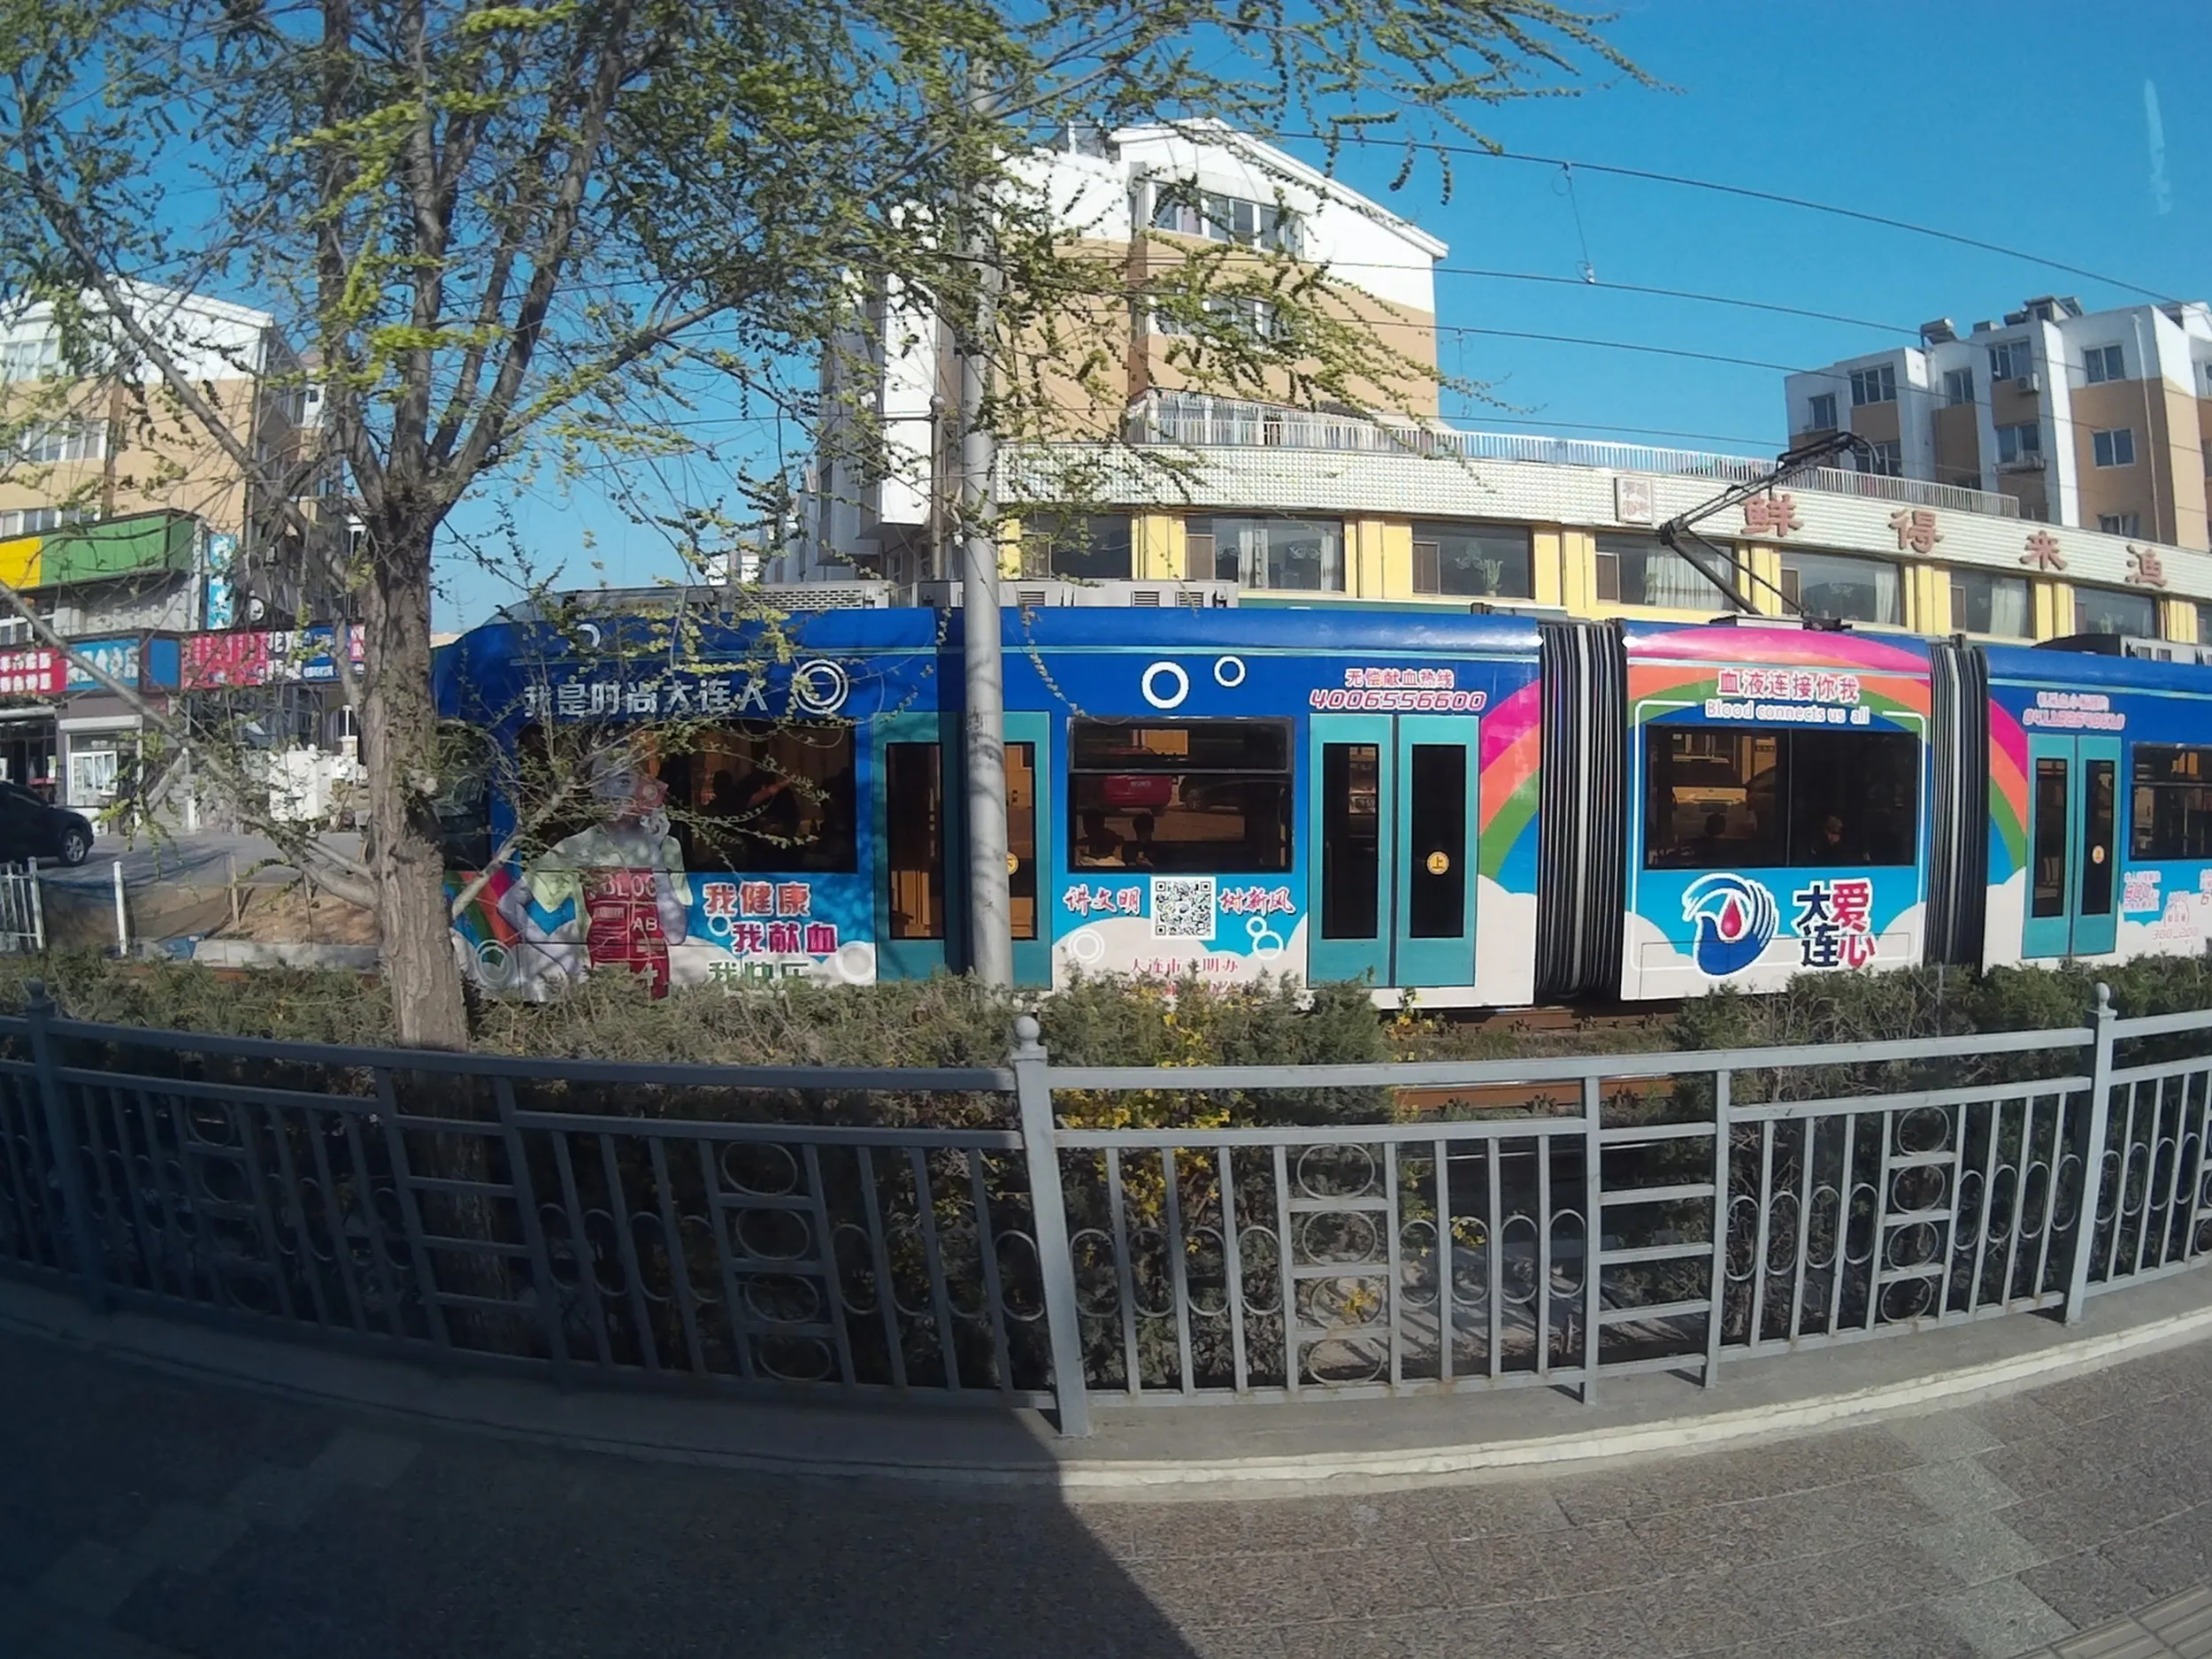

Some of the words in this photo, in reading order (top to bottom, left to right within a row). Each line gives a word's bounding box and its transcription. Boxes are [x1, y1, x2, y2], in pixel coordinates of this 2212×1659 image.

[1346, 669, 1454, 688] 无偿献血热线
[1718, 671, 1860, 702] 血液连接你我
[525, 680, 768, 718] 我是时尚大连人
[1310, 690, 1486, 710] 4006556600
[1706, 700, 1754, 718] Blood
[1756, 703, 1824, 723] connects
[1827, 707, 1846, 723] us
[1850, 706, 1870, 725] all
[1431, 856, 1446, 870] 上
[704, 882, 809, 915] 我健康
[1064, 887, 1141, 914] 讲文明
[1218, 887, 1294, 915] 树新风
[634, 918, 657, 932] AB
[732, 923, 838, 954] 我献血
